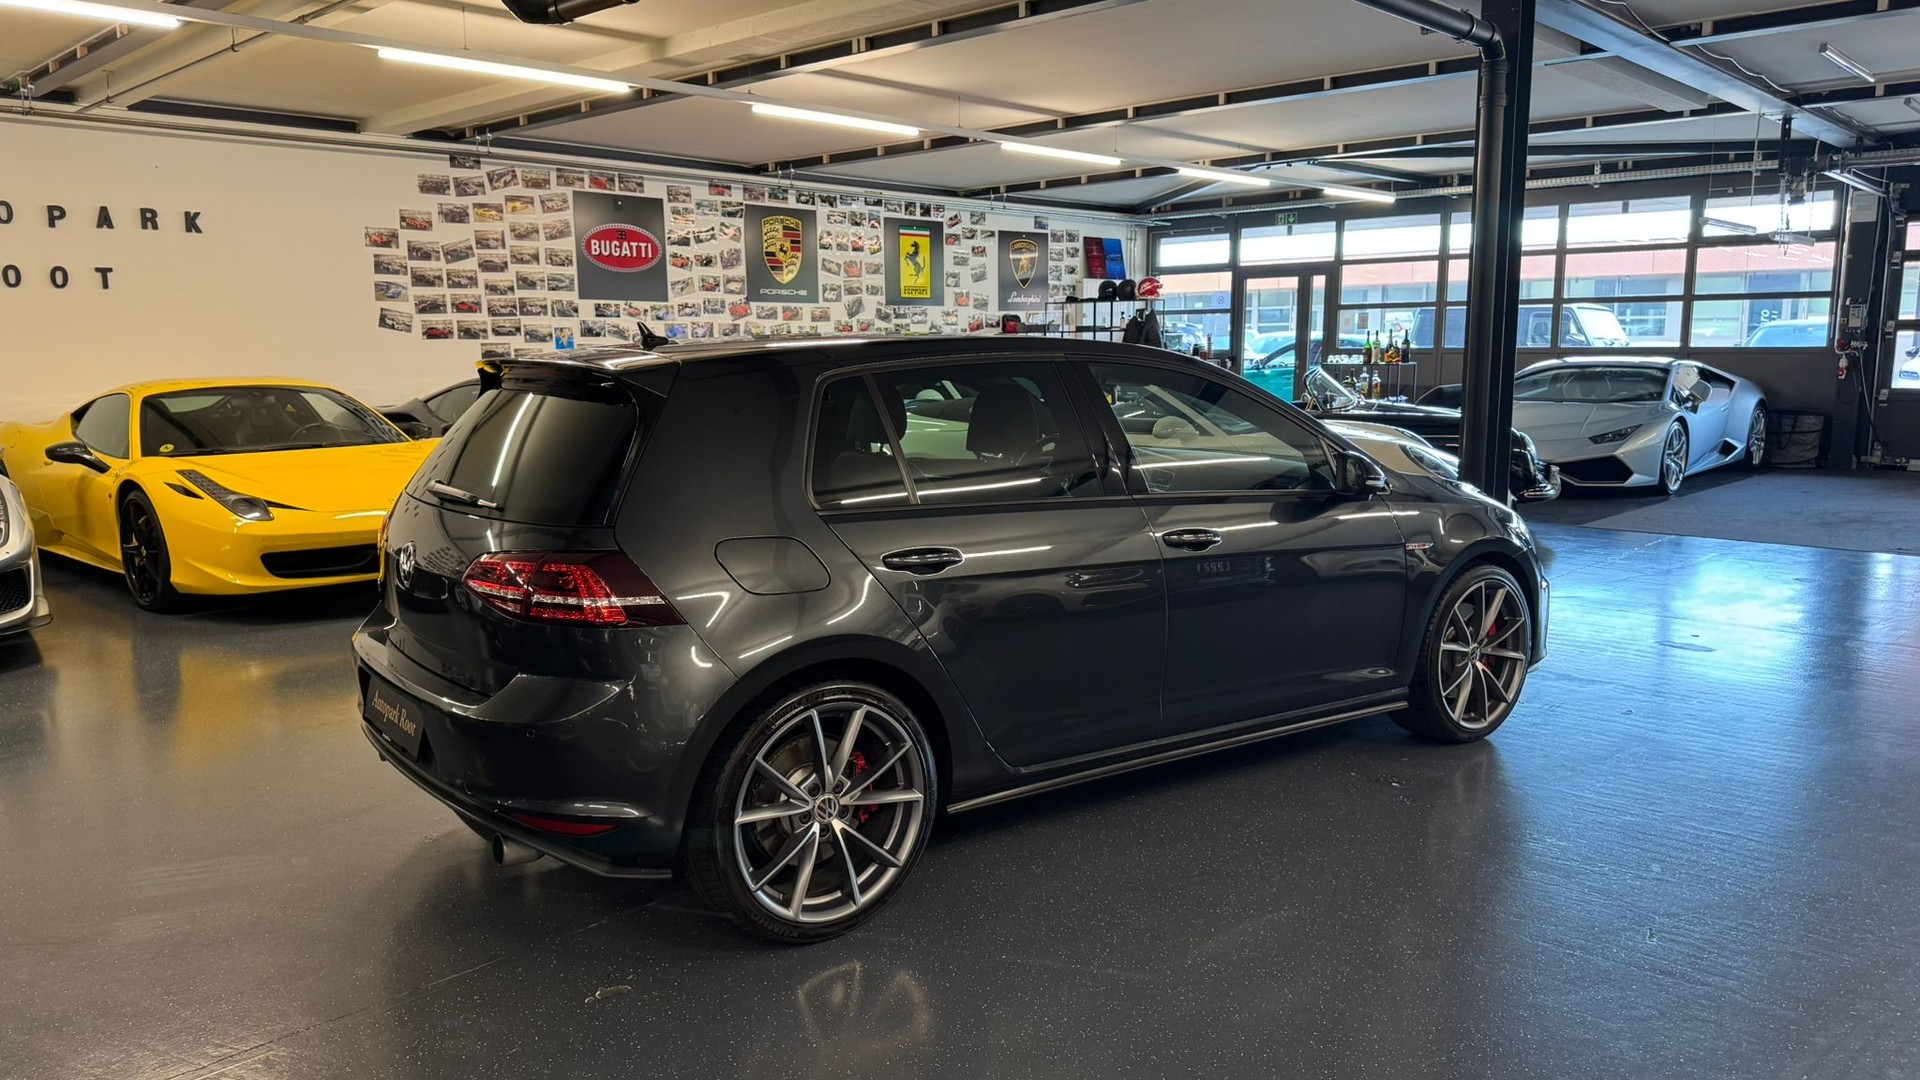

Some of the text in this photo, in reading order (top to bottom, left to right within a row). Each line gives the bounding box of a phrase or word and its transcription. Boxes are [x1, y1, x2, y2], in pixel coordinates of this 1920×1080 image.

[591, 239, 653, 258] BUGATTI
[760, 288, 807, 296] PORSCHE
[903, 286, 928, 296] Ferrari
